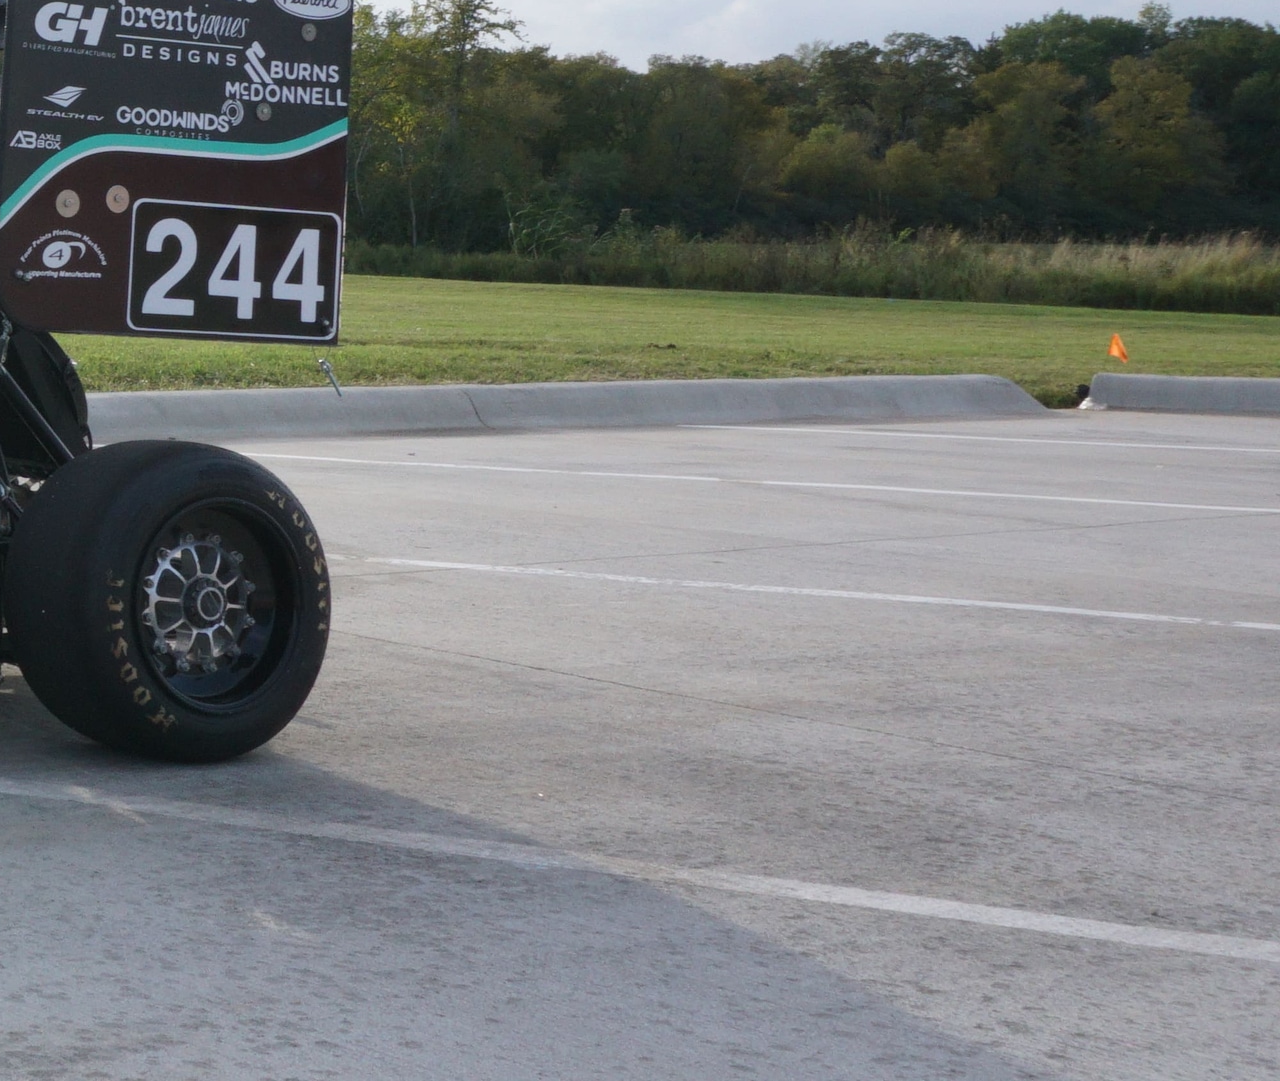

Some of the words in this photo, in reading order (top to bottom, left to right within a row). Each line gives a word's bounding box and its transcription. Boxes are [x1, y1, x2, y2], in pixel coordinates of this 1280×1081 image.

[122, 43, 238, 67] DESIGNS
[270, 60, 340, 83] BURNS
[225, 80, 348, 107] McDONNELL
[26, 108, 85, 120] STEALTH
[87, 114, 105, 122] EV
[116, 105, 230, 133] GOODWINDS
[39, 133, 62, 142] AXLE
[135, 127, 211, 141] COMPOSITES
[37, 139, 61, 151] BOX
[48, 248, 65, 261] 4
[142, 218, 325, 323] 244
